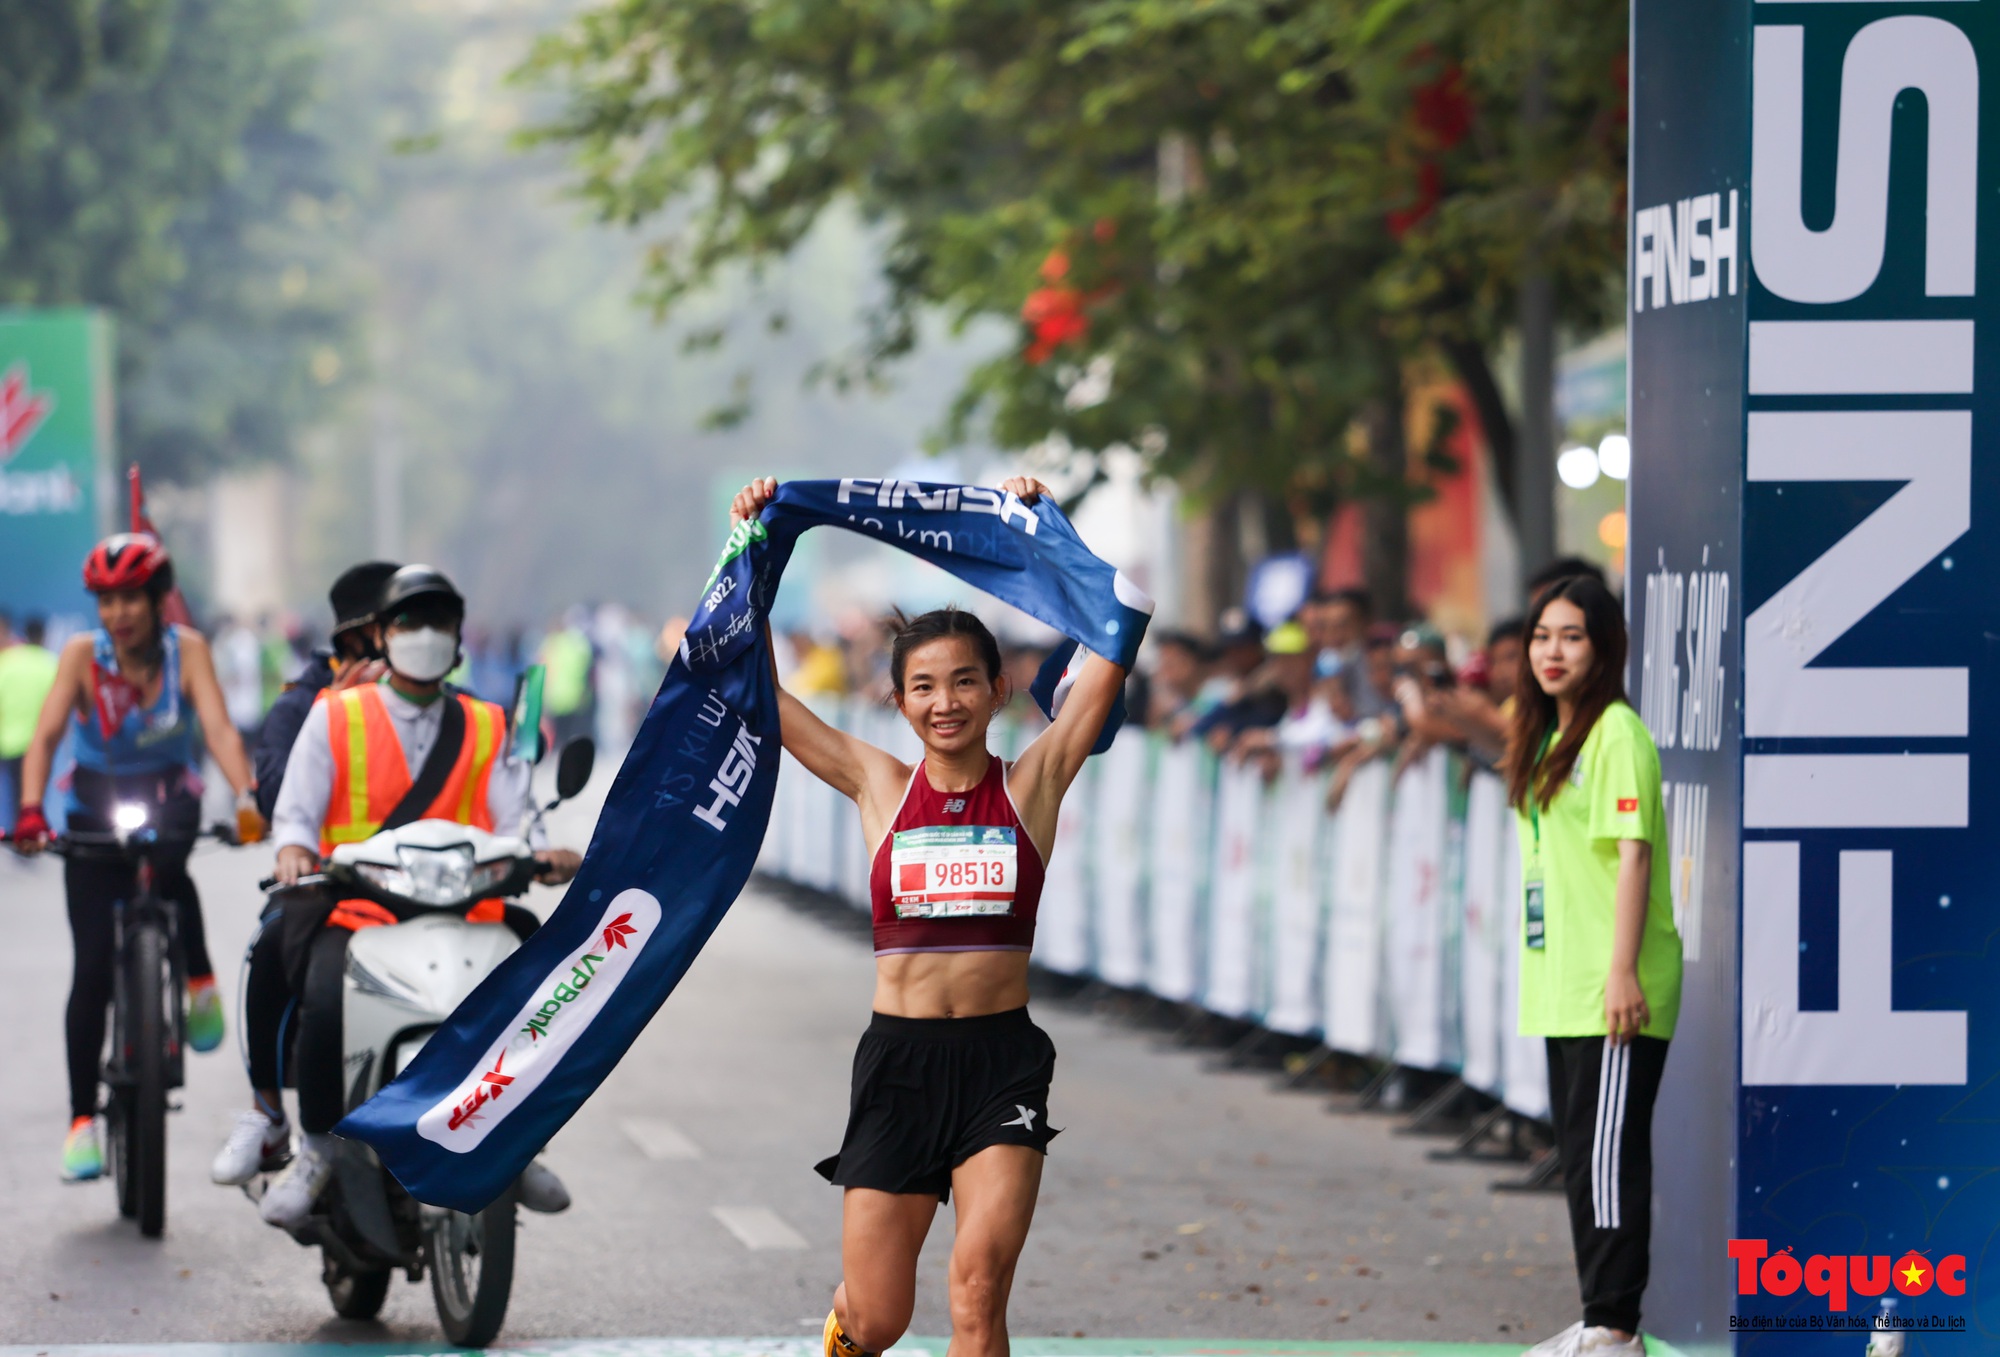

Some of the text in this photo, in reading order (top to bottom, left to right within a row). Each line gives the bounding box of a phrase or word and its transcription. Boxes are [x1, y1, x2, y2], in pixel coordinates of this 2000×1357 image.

[1634, 188, 1739, 313] FINISH
[836, 477, 1040, 537] FINISH
[1741, 0, 1980, 1086] FINIS
[704, 575, 738, 613] 2022
[686, 605, 758, 664] Heritage
[934, 860, 1005, 888] 98513
[520, 953, 605, 1042] VPBank
[447, 1045, 516, 1131] XTEP
